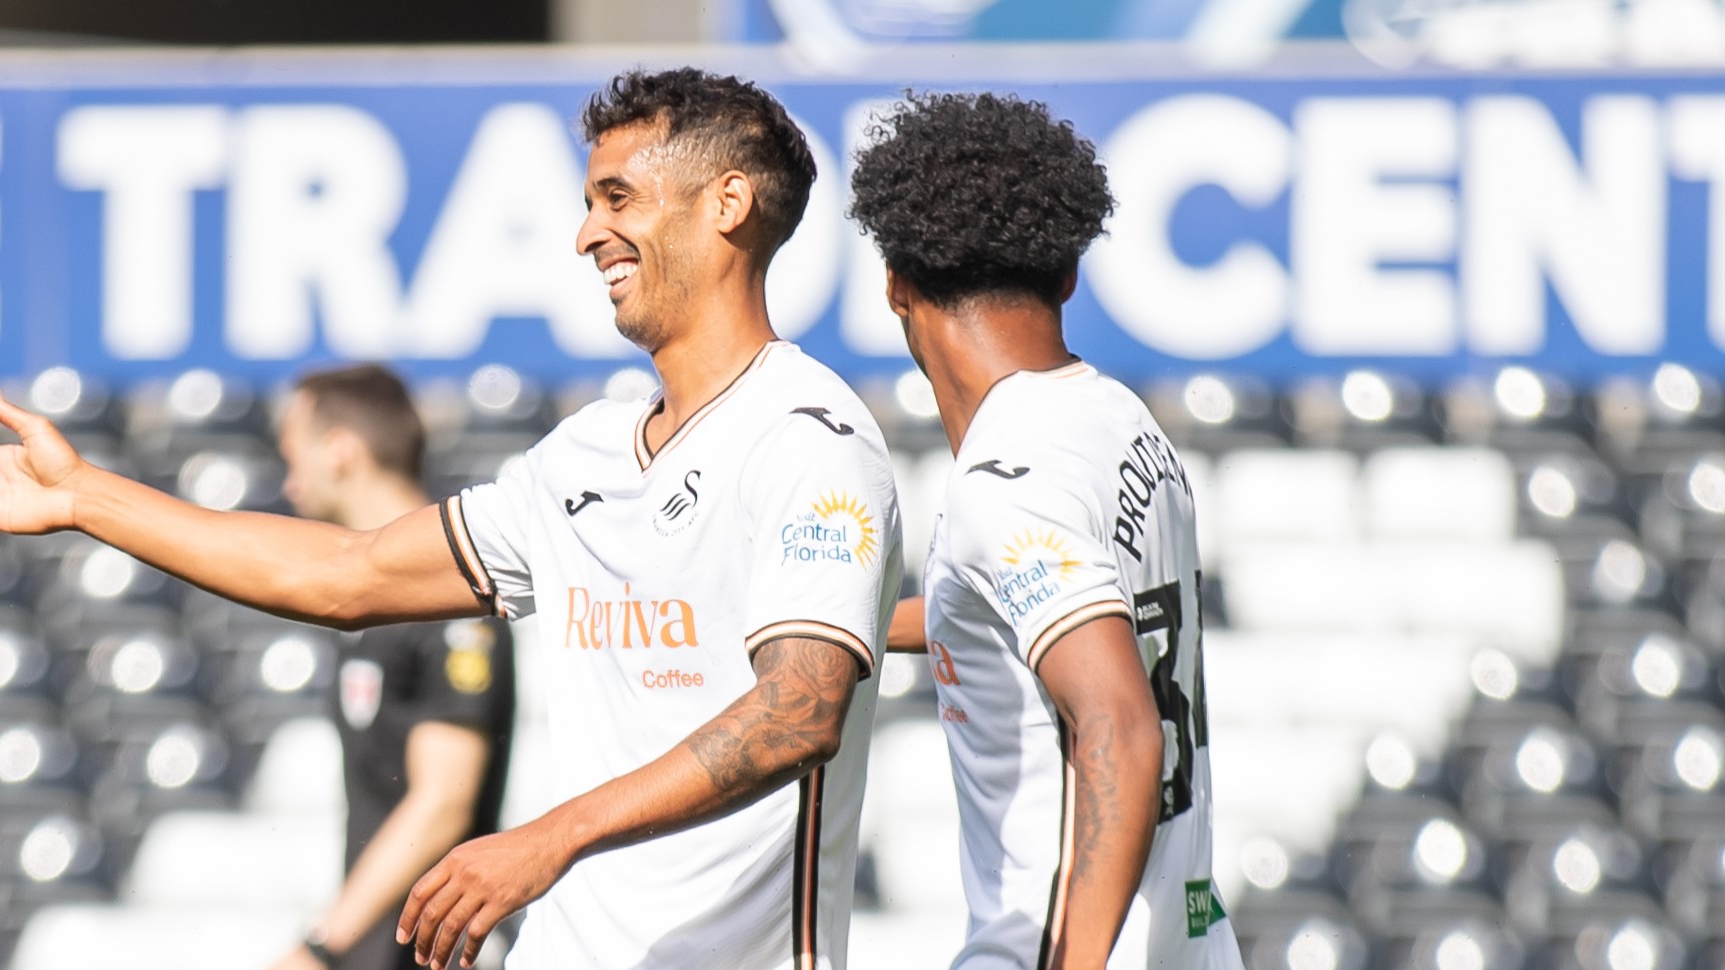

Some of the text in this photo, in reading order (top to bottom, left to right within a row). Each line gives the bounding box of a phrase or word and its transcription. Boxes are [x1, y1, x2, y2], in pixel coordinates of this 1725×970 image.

[781, 523, 847, 544] Central
[781, 544, 851, 567] Florida
[564, 581, 699, 649] Reviva
[642, 669, 704, 689] Coffee
